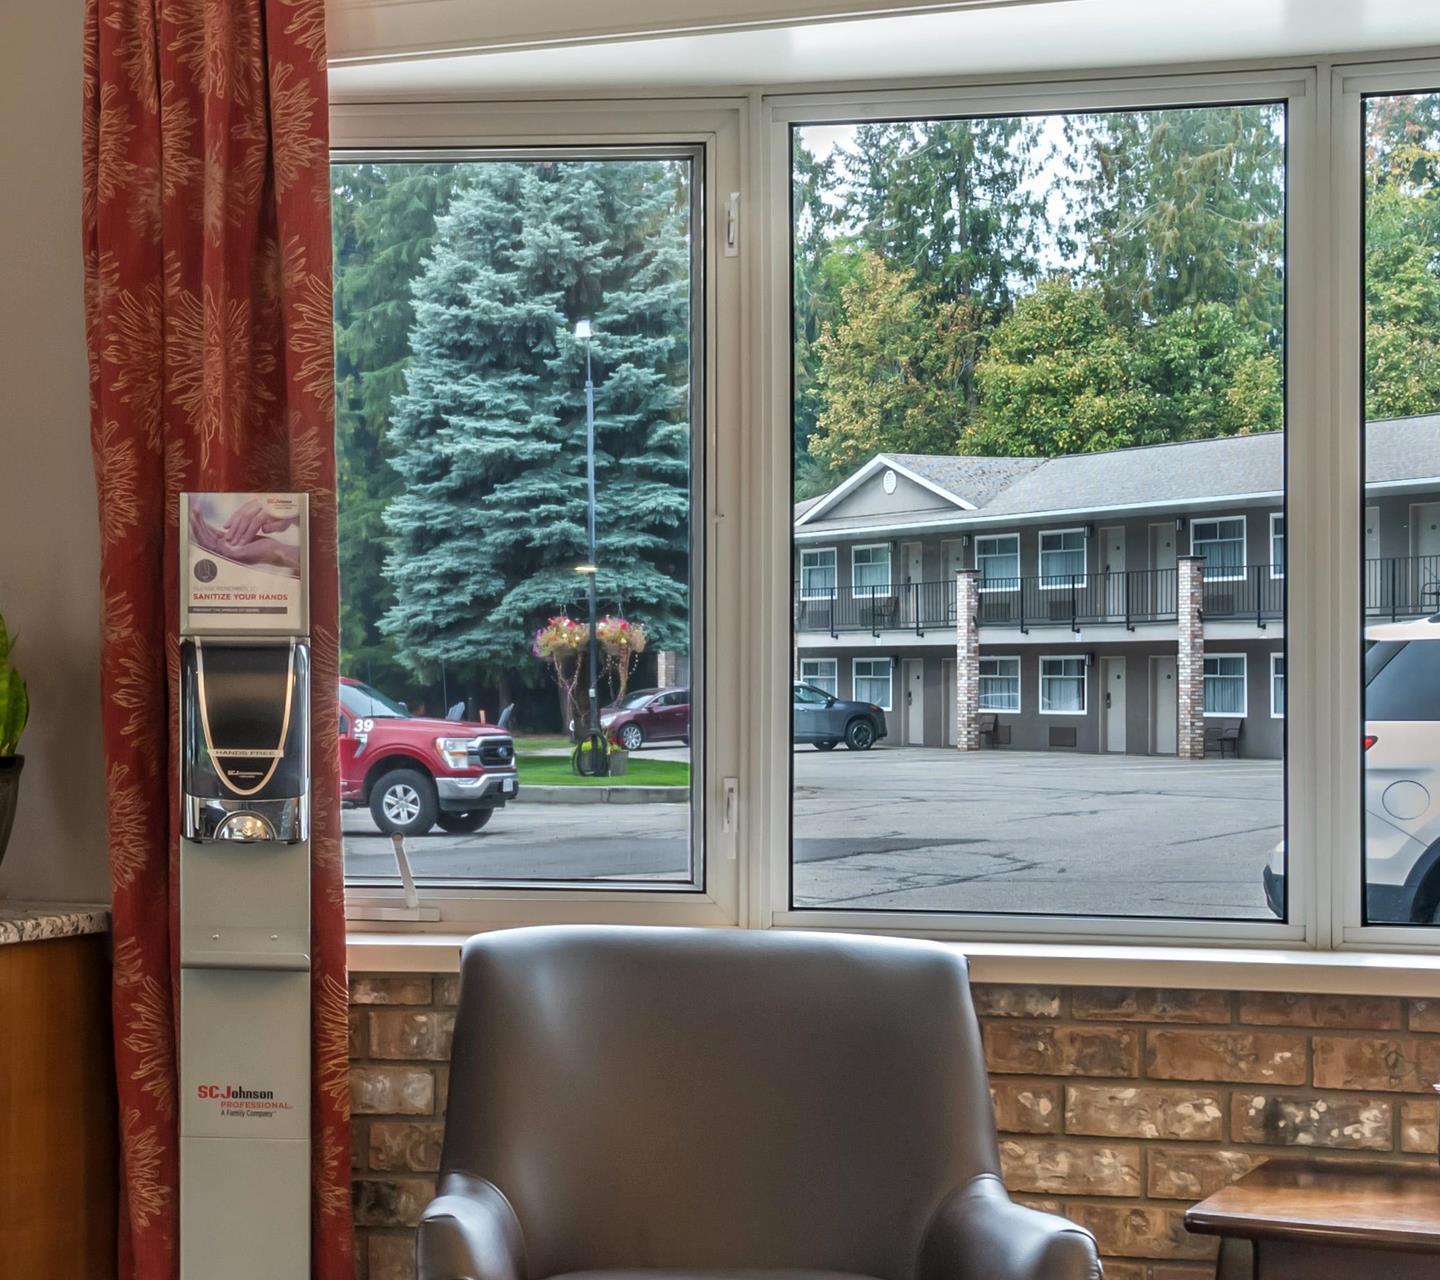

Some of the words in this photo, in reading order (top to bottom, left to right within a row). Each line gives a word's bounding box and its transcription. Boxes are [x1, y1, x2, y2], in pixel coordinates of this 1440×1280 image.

[193, 593, 231, 601] SANITIZE
[234, 593, 256, 601] YOUR
[259, 593, 288, 601] HANDS
[354, 718, 374, 733] 39
[246, 1110, 273, 1118] Company
